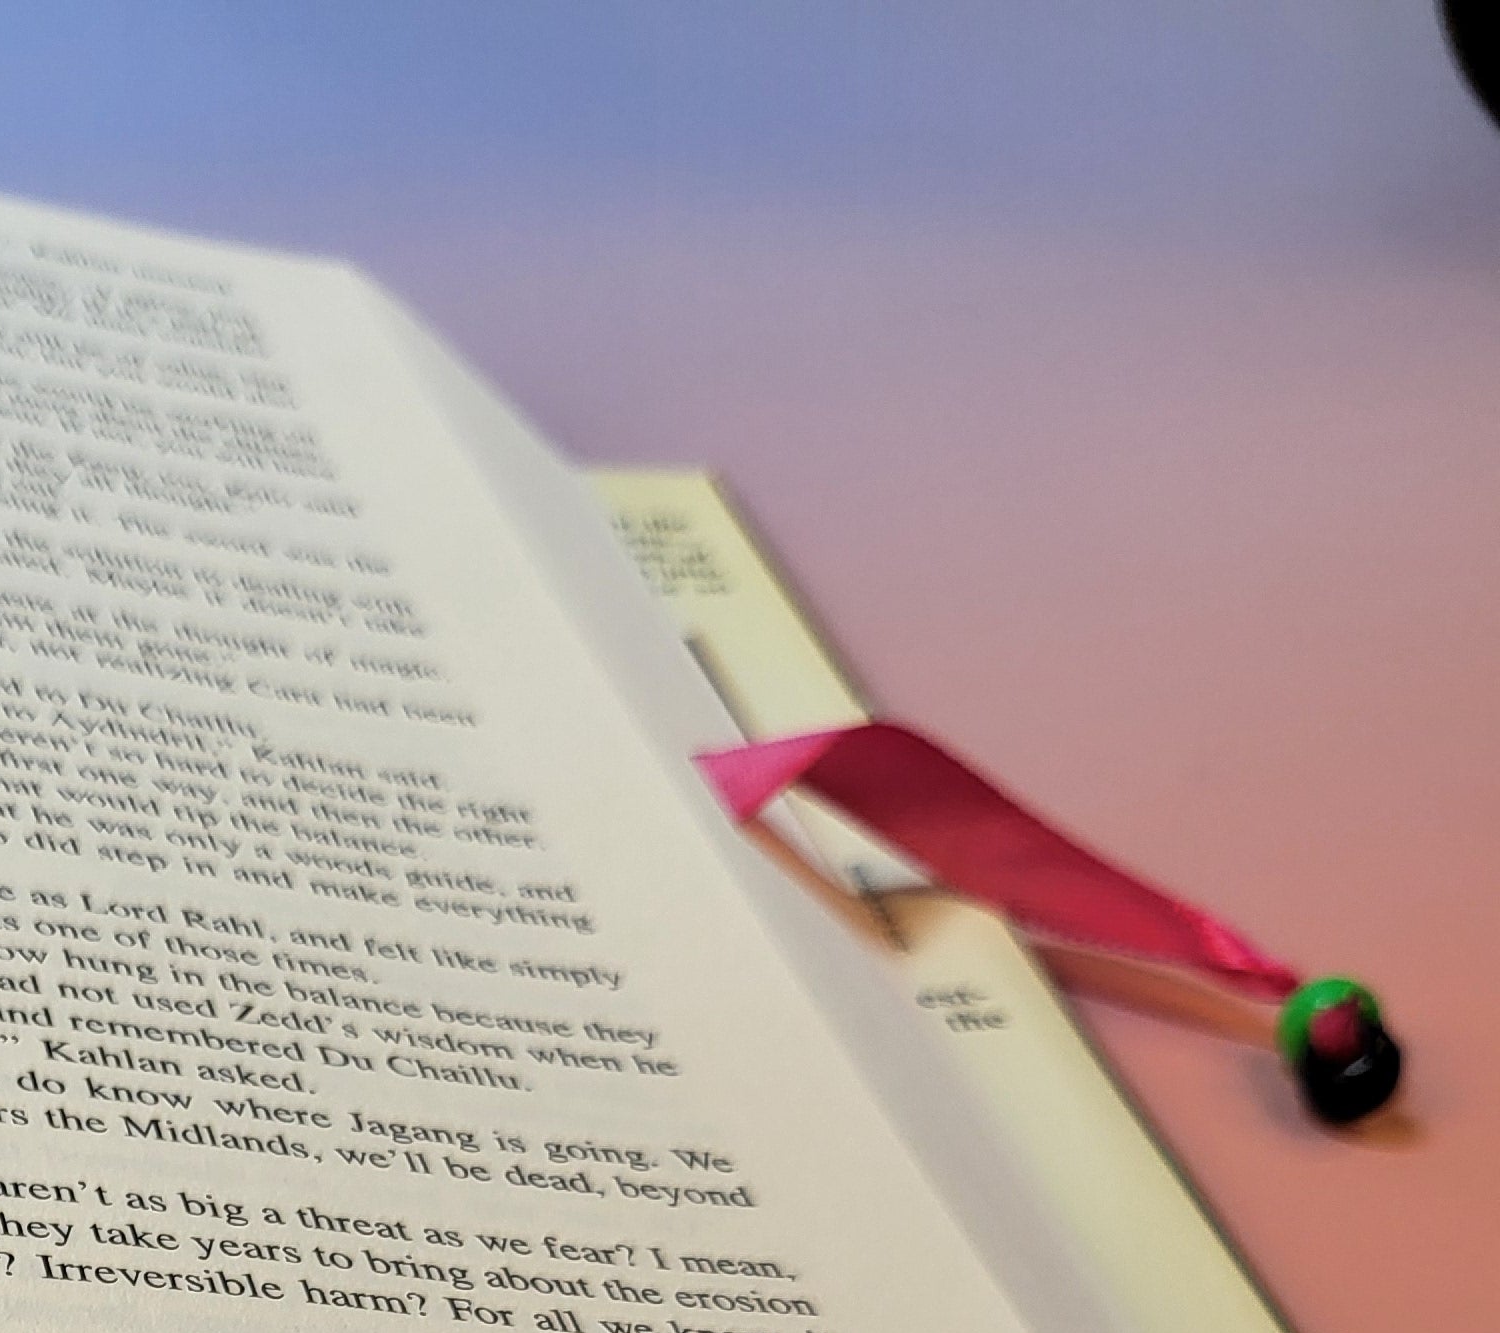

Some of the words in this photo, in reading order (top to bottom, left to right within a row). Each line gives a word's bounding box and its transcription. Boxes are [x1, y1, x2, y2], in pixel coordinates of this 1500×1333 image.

[39, 1038, 184, 1077] Kahlan
[196, 1063, 318, 1095] asked.
[15, 1069, 68, 1095] do
[82, 1075, 194, 1110] know
[212, 1097, 334, 1129] where
[347, 1111, 482, 1154] Jagang
[491, 1130, 528, 1154] is
[542, 1140, 660, 1172] going.
[668, 1149, 735, 1173] We
[42, 1106, 109, 1134] the
[118, 1114, 324, 1164] Midlands,
[332, 1147, 434, 1175] we’ll
[440, 1155, 494, 1182] be
[503, 1163, 607, 1199] dead,
[610, 1175, 757, 1208] beyond
[88, 1222, 181, 1251] take
[188, 1236, 304, 1264] years
[310, 1245, 356, 1270] to
[359, 1248, 476, 1291] bring
[482, 1266, 598, 1299] about
[600, 1279, 666, 1305] the
[673, 1289, 820, 1317] erosion
[124, 1192, 169, 1213] as
[175, 1191, 250, 1227] big
[260, 1207, 288, 1226] a
[294, 1206, 415, 1242] threat
[422, 1227, 466, 1248] as
[473, 1233, 534, 1256] we
[540, 1235, 638, 1267] fear?
[645, 1247, 673, 1271] I
[677, 1256, 798, 1283] mean,
[34, 1253, 286, 1300] Irreversible
[296, 1278, 428, 1317] harm?
[440, 1296, 516, 1327] For
